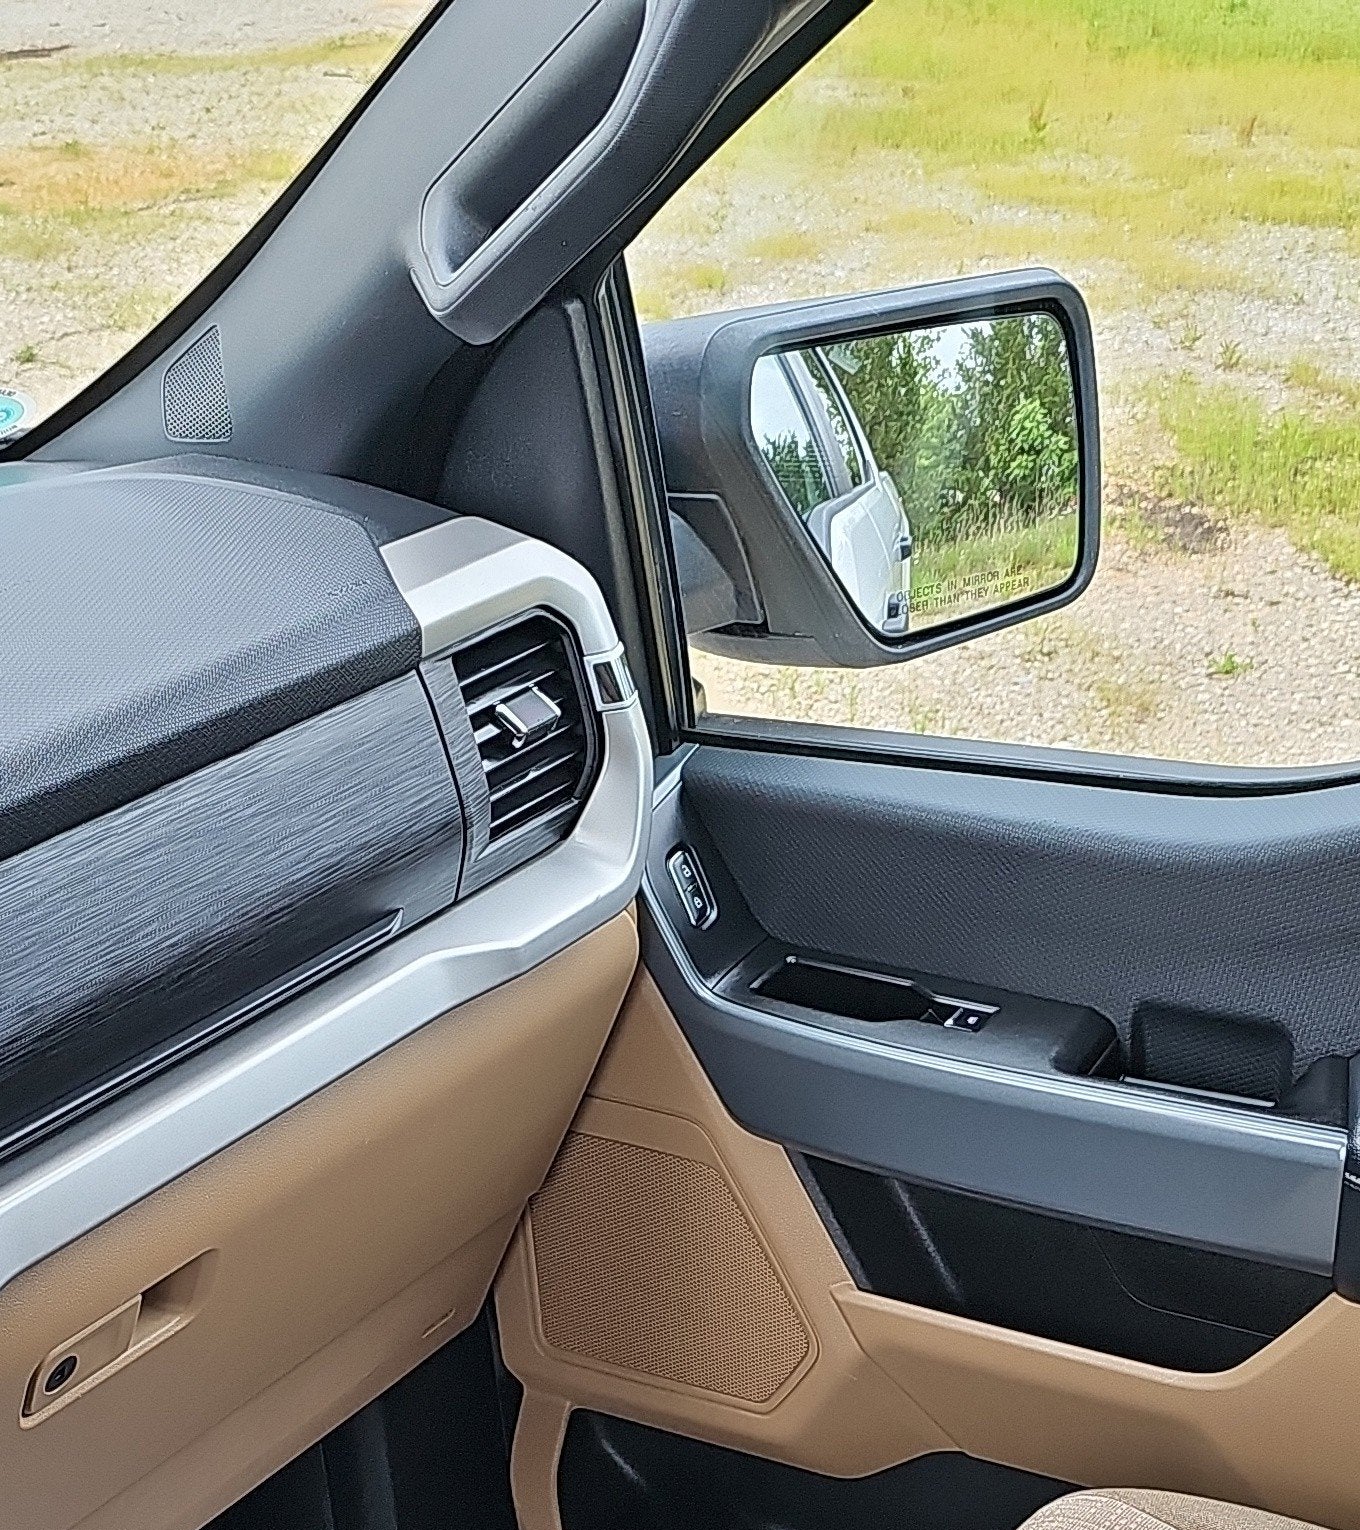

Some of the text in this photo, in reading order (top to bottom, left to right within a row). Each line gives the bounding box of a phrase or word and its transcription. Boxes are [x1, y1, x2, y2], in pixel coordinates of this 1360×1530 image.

[934, 593, 960, 607] THAN
[965, 587, 989, 600] THEY
[993, 576, 1030, 594] APPEAR
[947, 580, 957, 591] IN
[963, 570, 999, 588] MIRROR
[1004, 564, 1023, 578] ARE
